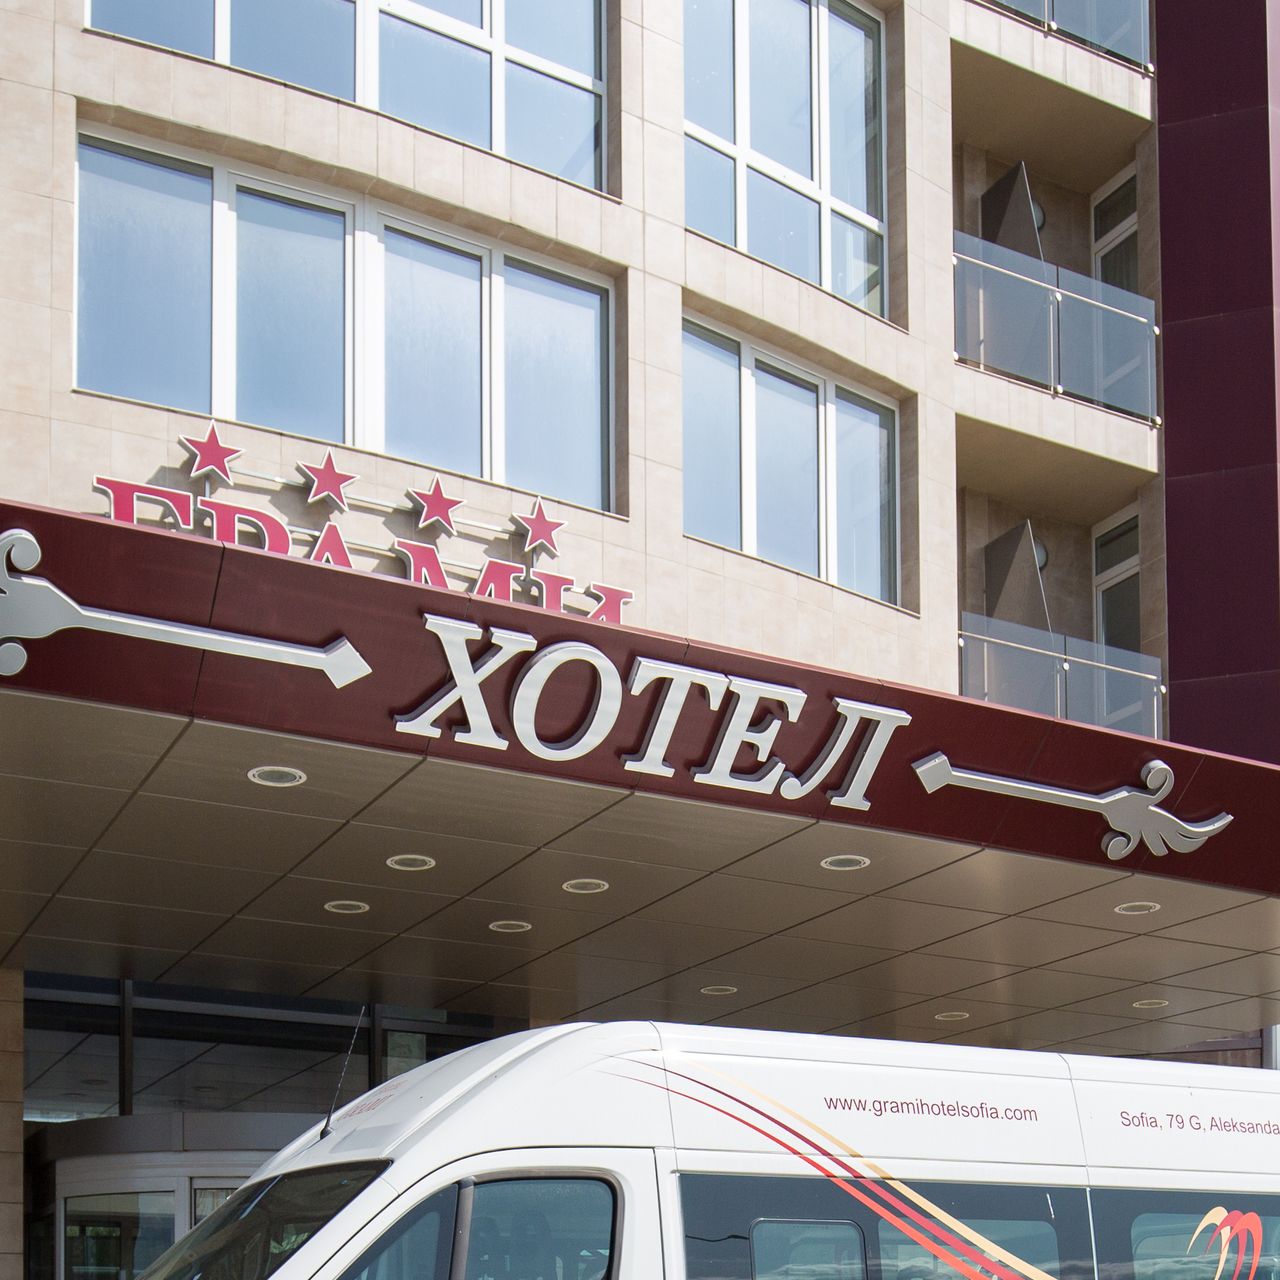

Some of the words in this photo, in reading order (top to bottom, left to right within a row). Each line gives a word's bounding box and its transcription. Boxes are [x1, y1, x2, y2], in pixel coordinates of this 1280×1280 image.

[393, 612, 912, 812] ХОТЕЛ
[823, 1096, 1039, 1122] www.gramihotelsofia.com
[1119, 1111, 1163, 1130] Sofia,
[1166, 1113, 1185, 1130] 79
[1189, 1115, 1206, 1132] G,
